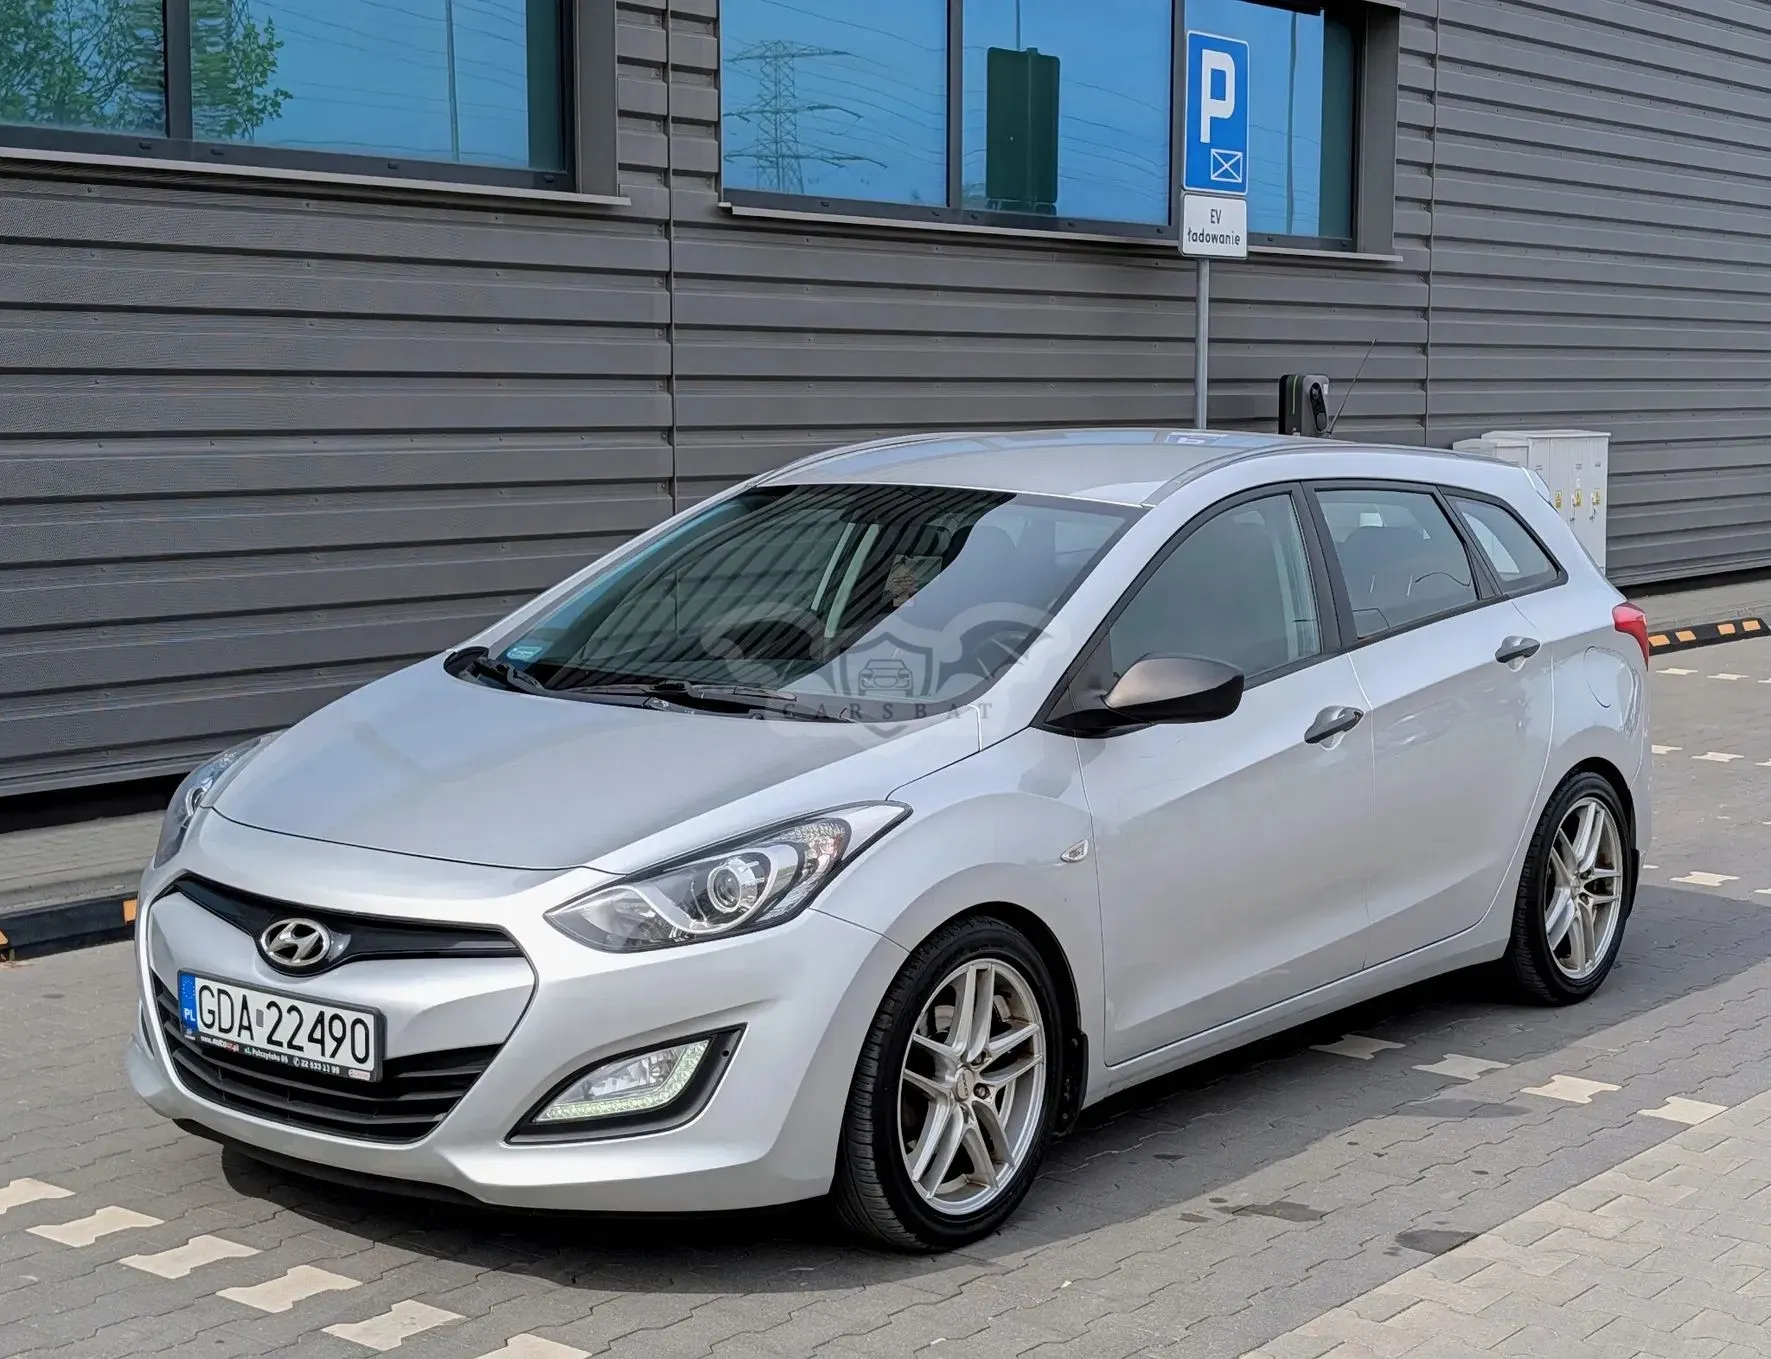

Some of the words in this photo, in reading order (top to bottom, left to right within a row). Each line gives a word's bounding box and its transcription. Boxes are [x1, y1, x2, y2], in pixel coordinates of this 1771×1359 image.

[1200, 48, 1235, 144] P
[1210, 208, 1222, 225] EV
[1186, 229, 1241, 246] ładowanie
[183, 1007, 196, 1022] PL
[198, 984, 255, 1041] GDA
[265, 1000, 370, 1065] 22490
